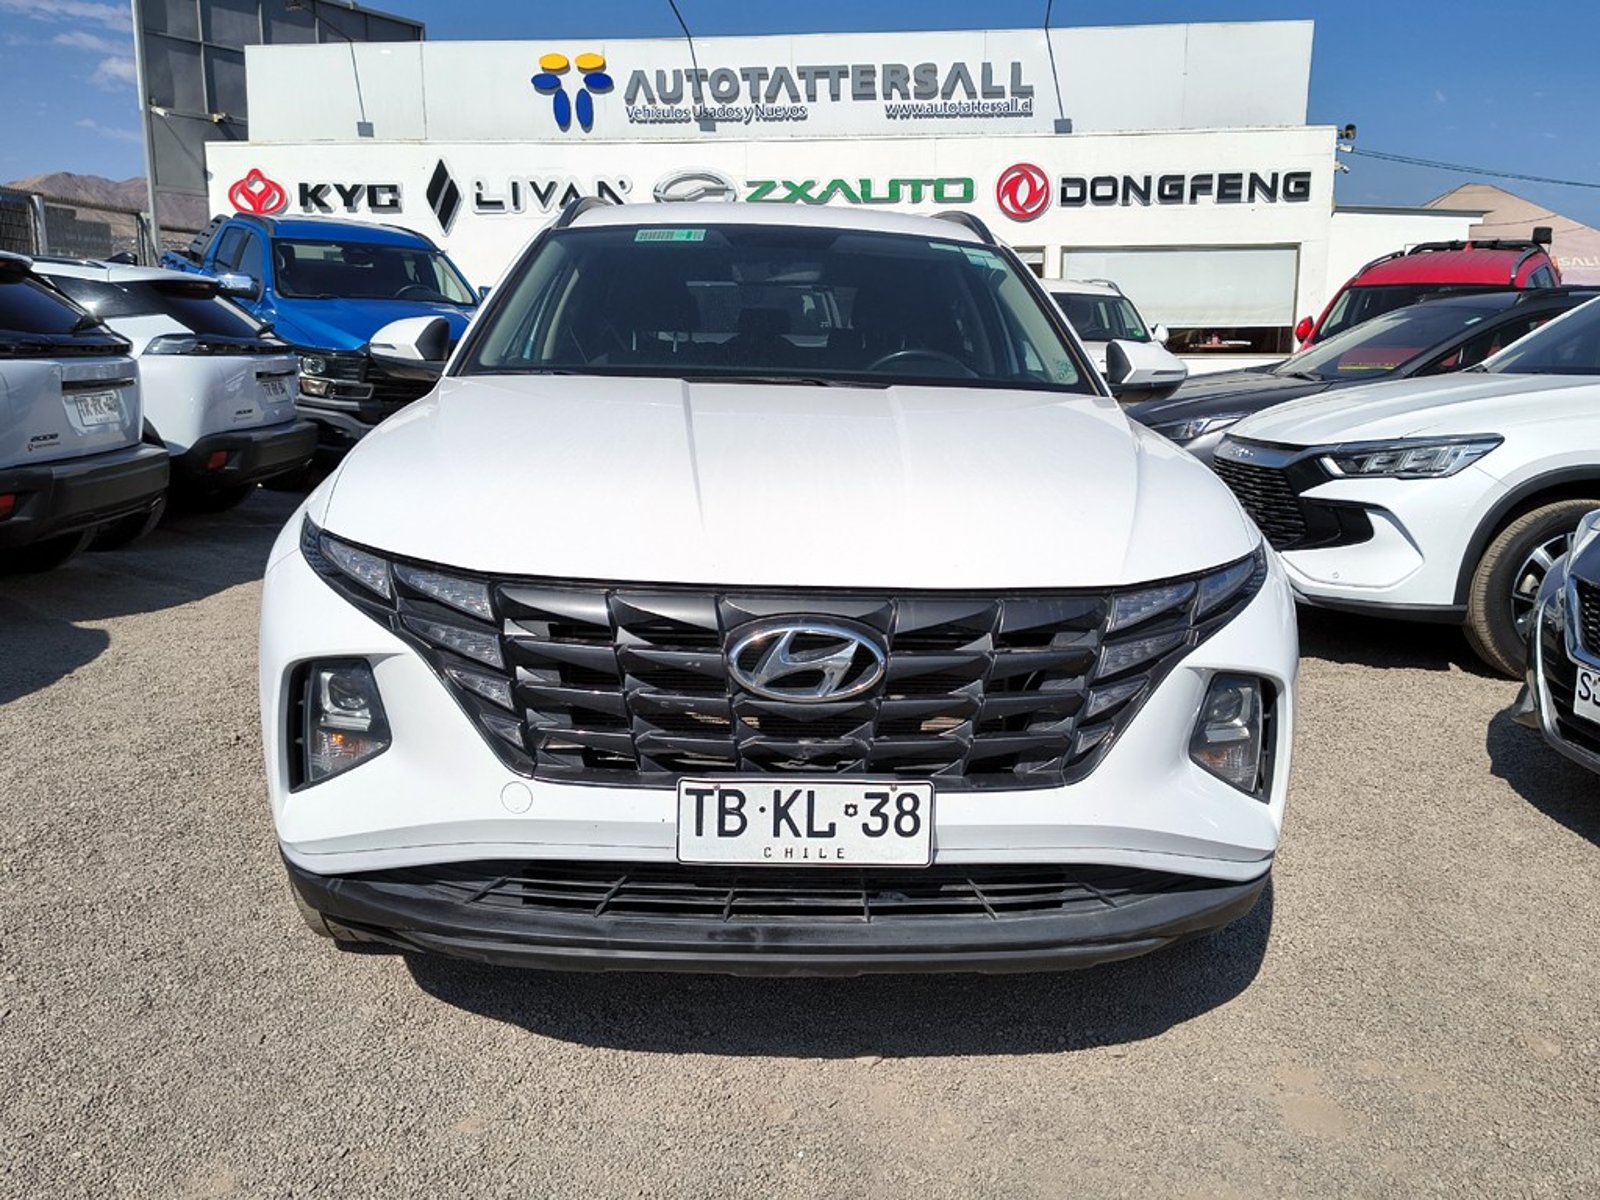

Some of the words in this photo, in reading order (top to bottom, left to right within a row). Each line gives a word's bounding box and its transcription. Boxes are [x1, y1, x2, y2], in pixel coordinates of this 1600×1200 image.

[624, 62, 1034, 105] AUTOTATTERSALL
[692, 105, 743, 122] Usados
[744, 107, 754, 125] y
[755, 103, 808, 121] Nuevos
[885, 98, 1033, 119] www.autotattersall.cl
[746, 178, 974, 205] ZXAUTO
[1060, 172, 1312, 207] DONGFENG
[763, 847, 845, 859] CHILE
